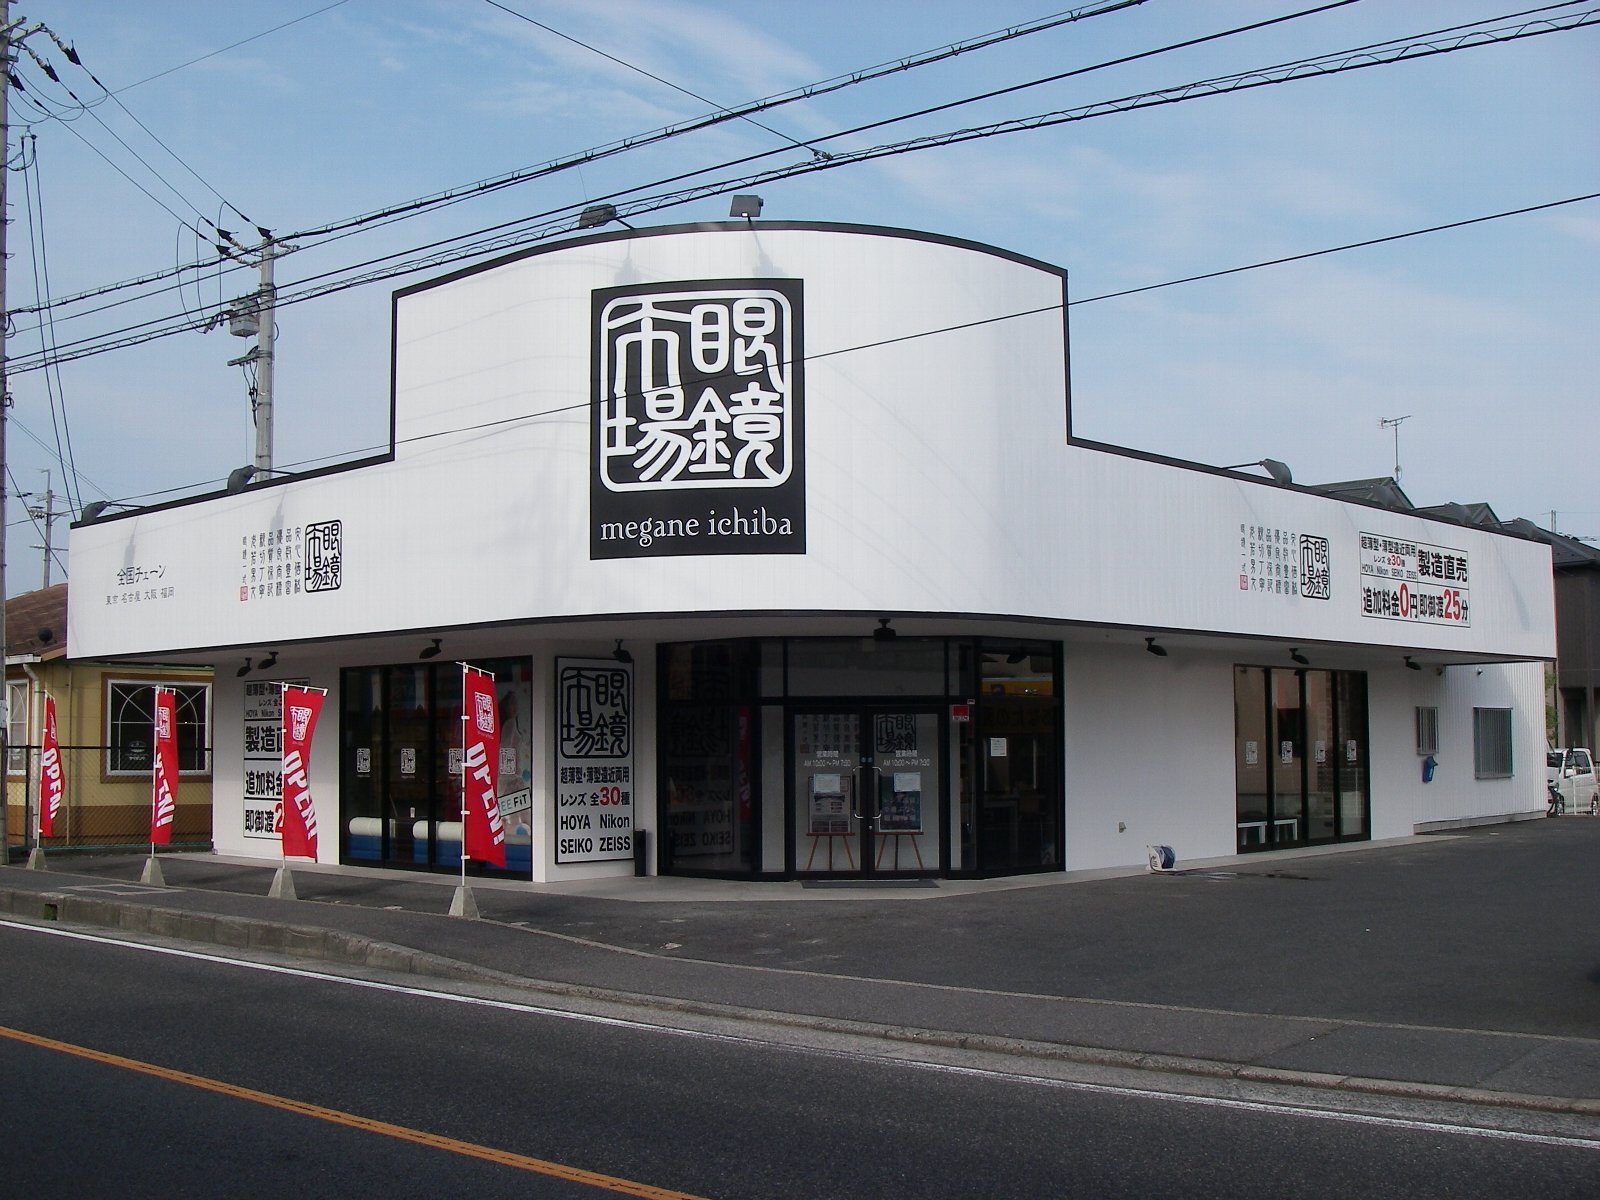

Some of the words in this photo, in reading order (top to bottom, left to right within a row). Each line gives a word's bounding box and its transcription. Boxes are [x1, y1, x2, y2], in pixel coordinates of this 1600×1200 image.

[600, 517, 699, 547] megane
[708, 506, 793, 536] ichiba
[1361, 564, 1374, 573] HOYA
[1418, 549, 1468, 582] 製造直売
[117, 565, 166, 585] 全国チェーン
[144, 589, 157, 600] 大阪
[561, 792, 587, 807] レンズ
[560, 814, 591, 830] HOYA
[600, 813, 630, 829] Nikon
[560, 837, 593, 854] SEIKO
[599, 836, 631, 852] ZEISS
